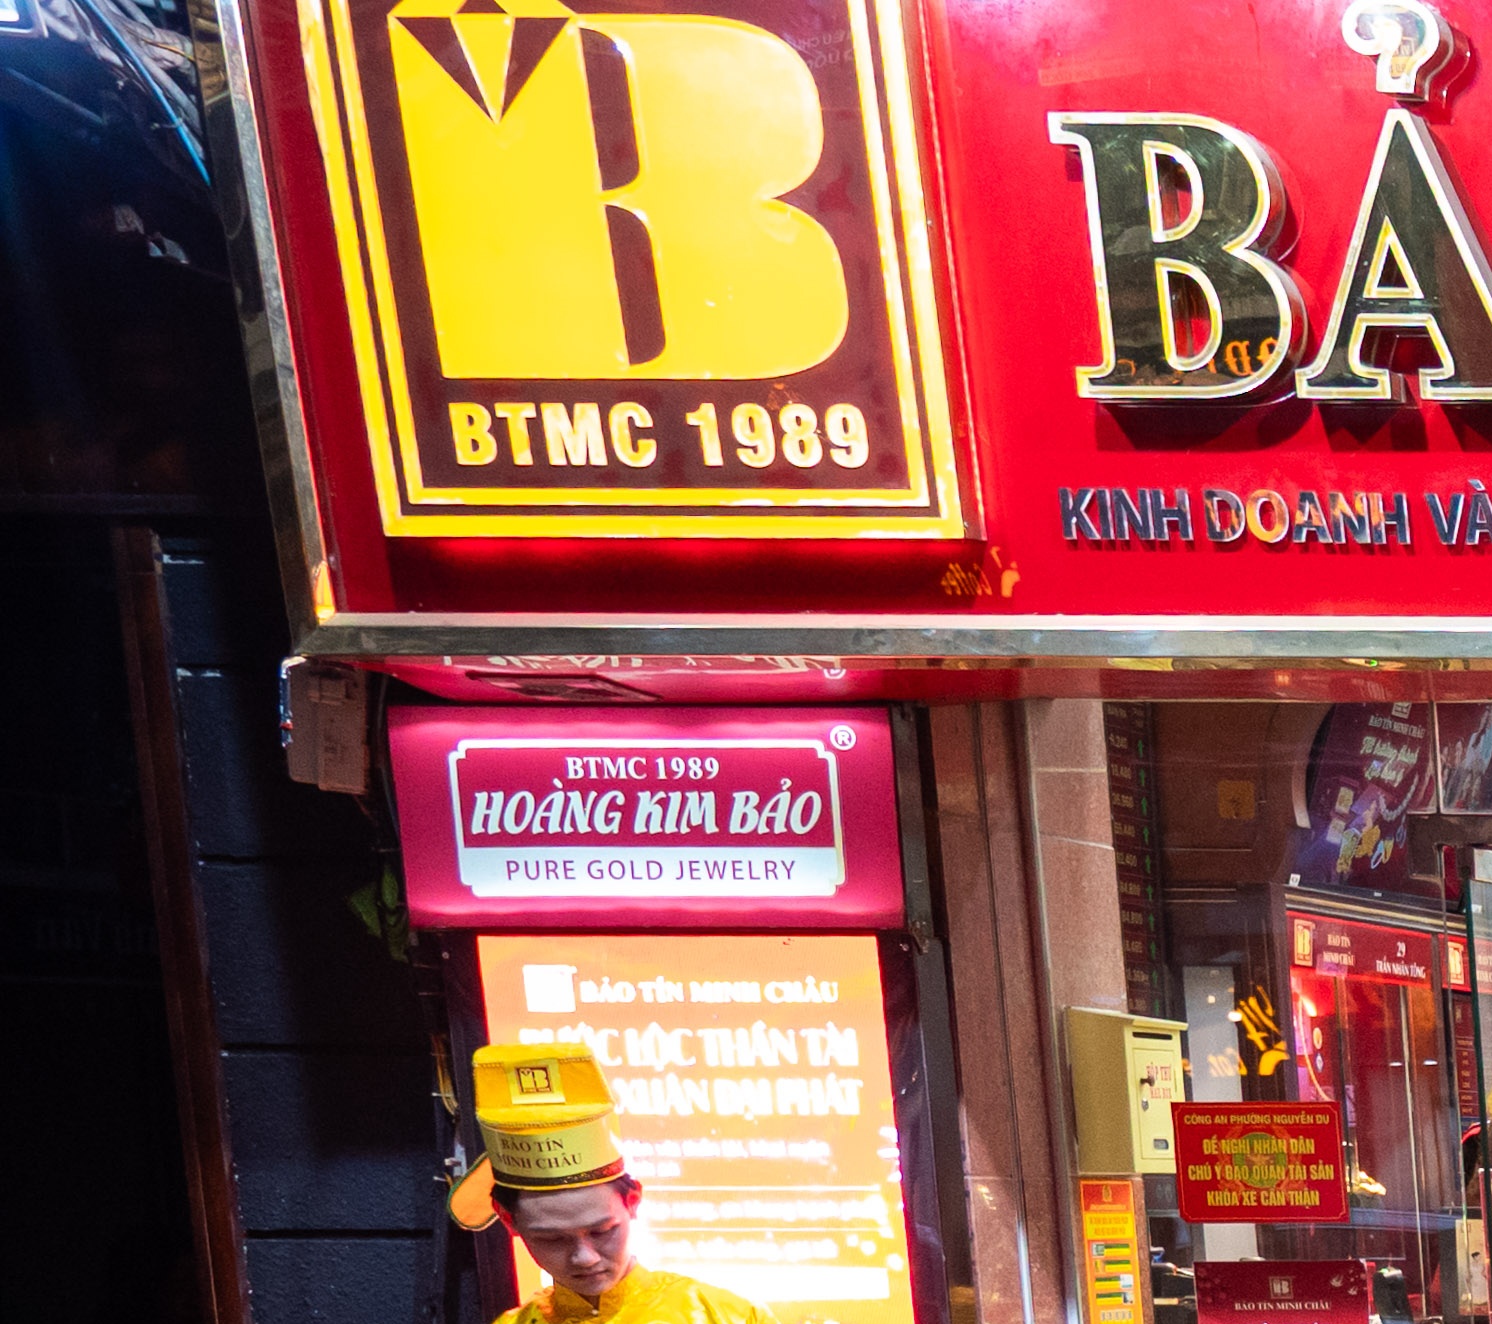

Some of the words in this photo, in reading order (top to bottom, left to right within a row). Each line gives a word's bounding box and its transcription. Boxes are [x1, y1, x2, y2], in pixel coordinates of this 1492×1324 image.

[450, 402, 657, 468] BTMC
[685, 402, 869, 470] 1989
[1059, 488, 1192, 544] KINH
[1203, 488, 1411, 546] DOANH
[565, 756, 648, 780] BTMC
[654, 756, 720, 780] 1989
[471, 778, 623, 835] HOÀNG
[634, 791, 718, 836] KIM
[728, 778, 822, 835] BẢO
[506, 859, 577, 881] PURE
[586, 859, 665, 881] GOLD
[676, 859, 798, 882] JEWELRY
